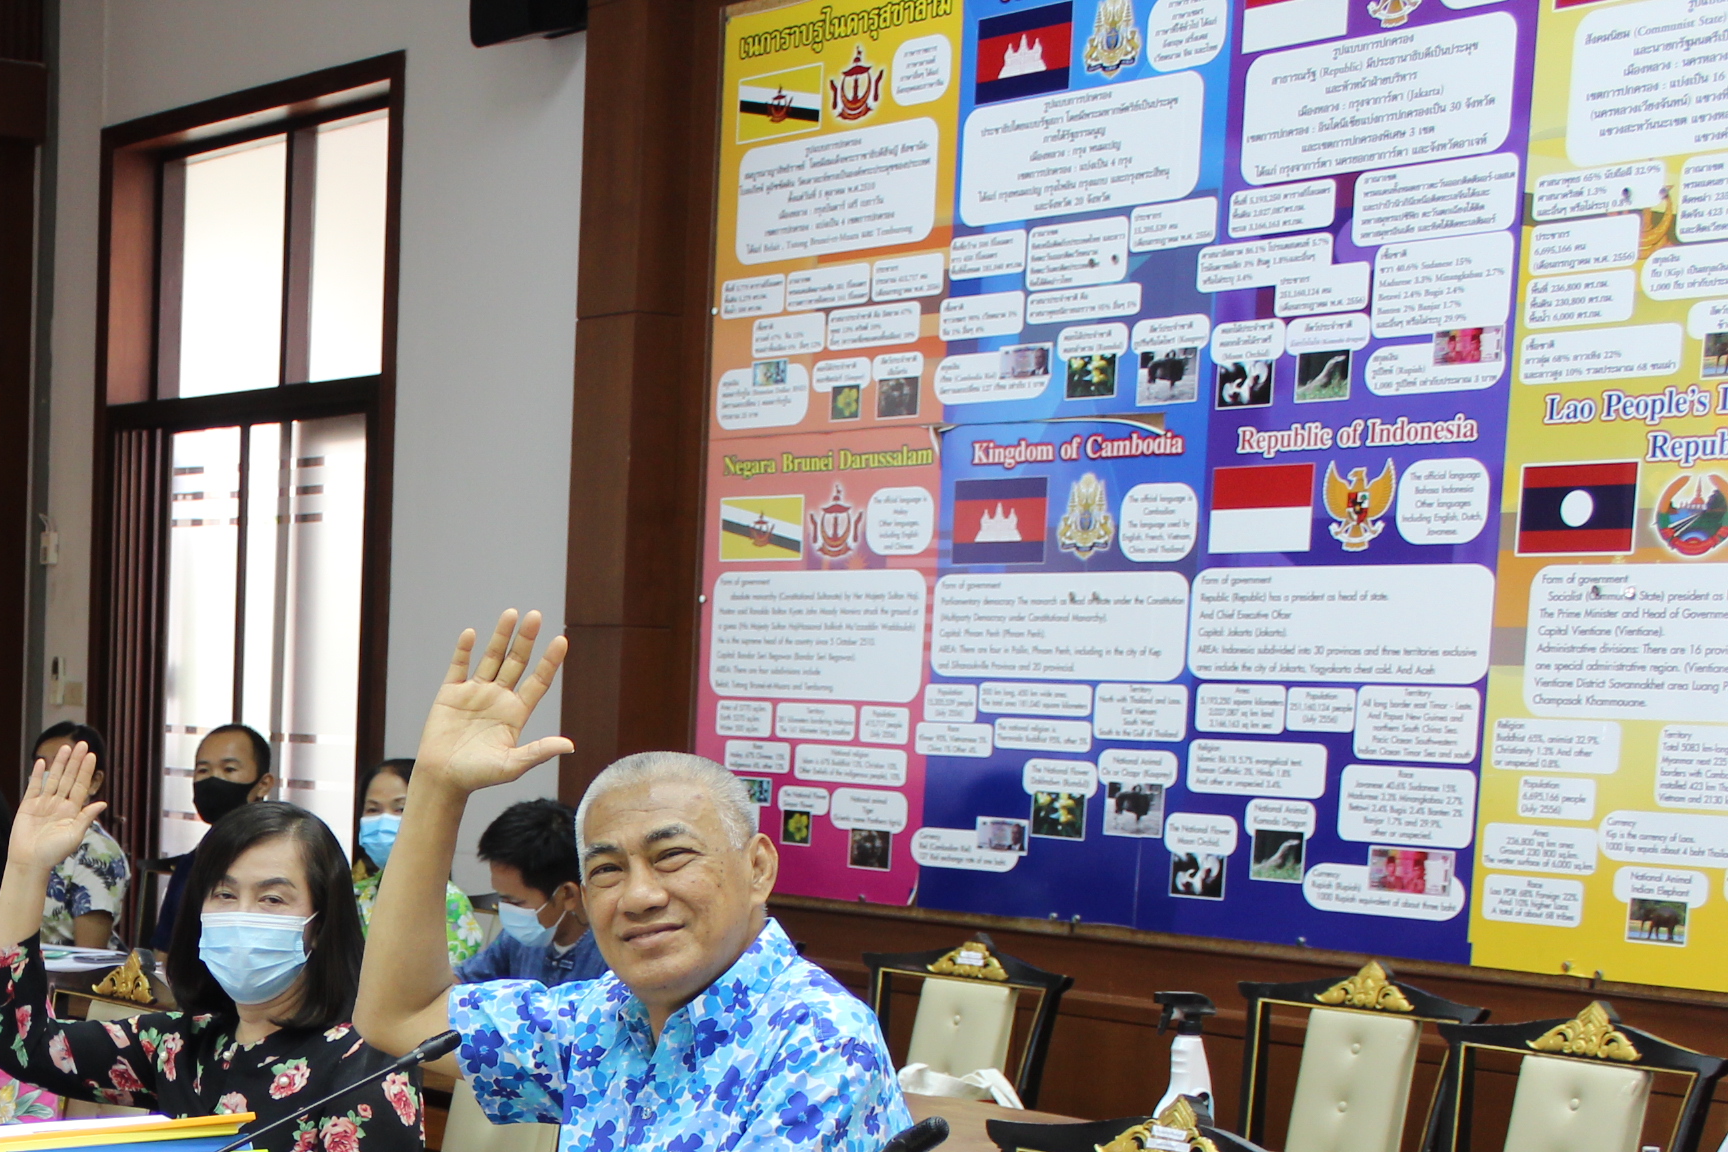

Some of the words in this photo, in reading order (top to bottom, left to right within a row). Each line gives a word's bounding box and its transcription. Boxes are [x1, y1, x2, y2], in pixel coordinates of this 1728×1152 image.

[1634, 20, 1695, 38] (Communist
[1698, 12, 1727, 27] State)
[1320, 62, 1363, 81] (Republic)
[1712, 71, 1725, 82] 16
[1449, 102, 1462, 112] 30
[1409, 128, 1414, 137] 3
[1546, 393, 1594, 421] Lao
[1603, 389, 1709, 421] People’s
[1238, 426, 1332, 457] Republic
[1342, 422, 1364, 447] of
[1369, 415, 1478, 445] Indonesia
[973, 440, 1054, 468] Kingdom
[1060, 436, 1081, 461] of
[1085, 432, 1183, 459] Cambodia
[724, 453, 776, 477] Negara
[782, 450, 833, 473] Brunei
[839, 446, 934, 472] Darussalam
[1542, 574, 1563, 584] Form
[1566, 573, 1575, 584] of
[1578, 574, 1628, 587] government
[1548, 590, 1582, 601] Socialist
[1639, 590, 1664, 603] State)
[1668, 590, 1712, 605] president
[1712, 593, 1721, 602] as
[1539, 609, 1554, 619] The
[1557, 609, 1580, 619] Prime
[1584, 608, 1619, 619] Minister
[1622, 608, 1639, 619] and
[1643, 609, 1666, 619] Head
[1669, 607, 1680, 619] of
[1572, 625, 1611, 636] Vientiane
[1642, 643, 1667, 655] There
[1670, 645, 1686, 655] are
[1690, 644, 1701, 655] 16
[1535, 662, 1551, 671] one
[1534, 677, 1573, 688] Vientiane
[1667, 681, 1689, 691] area
[1691, 681, 1720, 694] Luang
